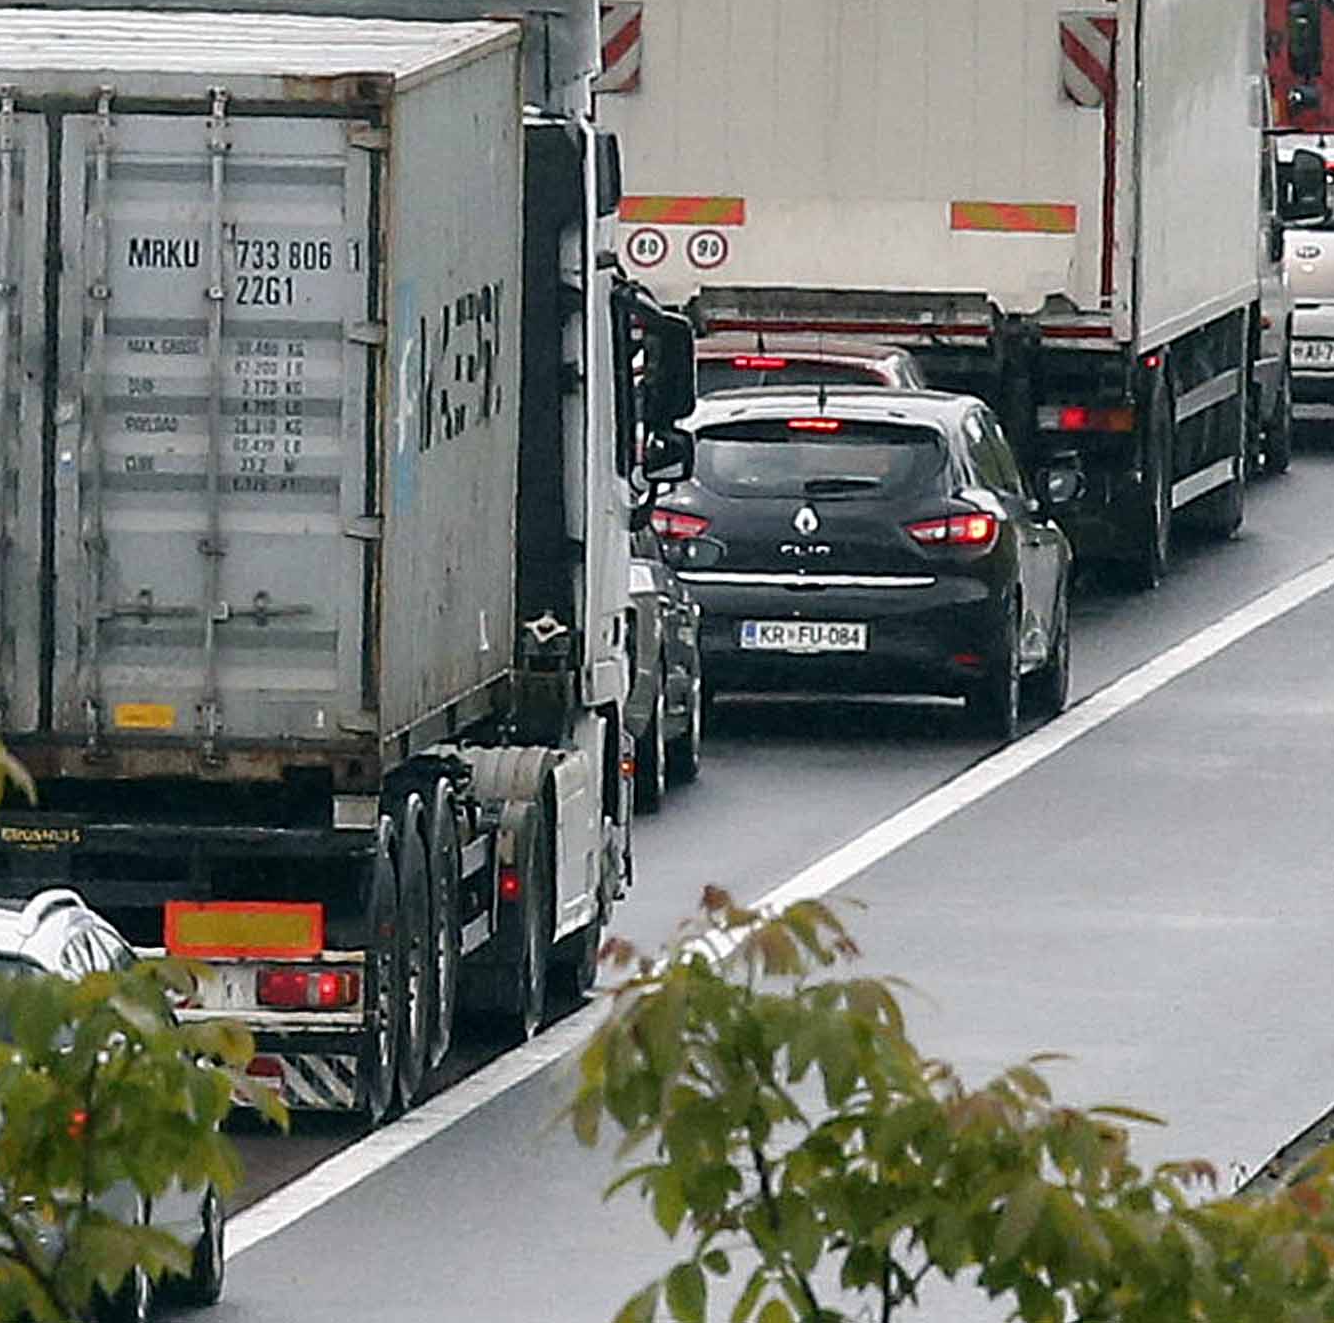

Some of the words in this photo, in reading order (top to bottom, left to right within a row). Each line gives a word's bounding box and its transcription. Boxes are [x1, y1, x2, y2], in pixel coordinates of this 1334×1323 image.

[128, 238, 200, 268] MRKU
[236, 240, 280, 270] 733
[289, 241, 332, 271] 806
[759, 625, 785, 644] KR
[798, 626, 860, 646] FU-084
